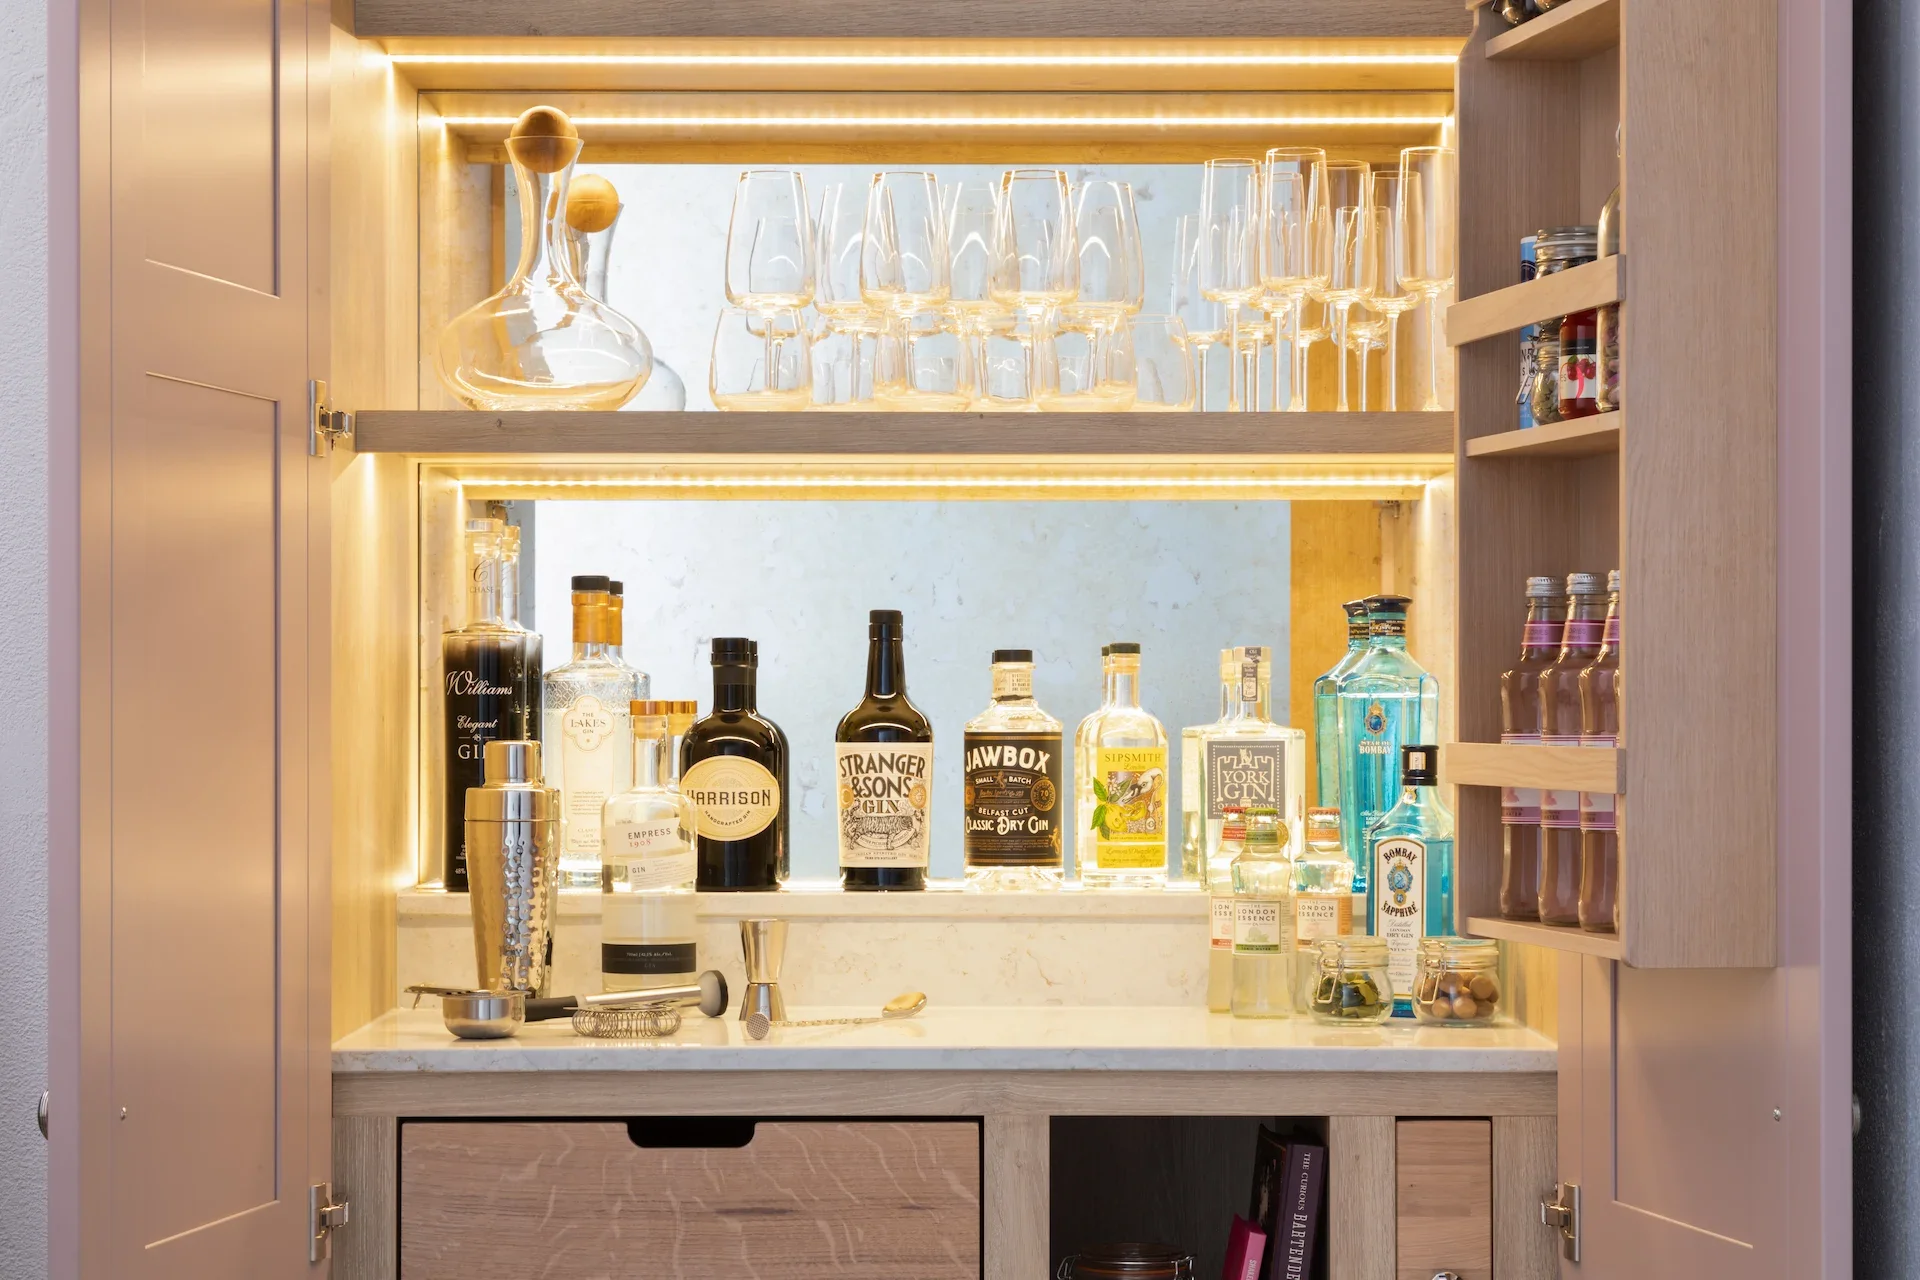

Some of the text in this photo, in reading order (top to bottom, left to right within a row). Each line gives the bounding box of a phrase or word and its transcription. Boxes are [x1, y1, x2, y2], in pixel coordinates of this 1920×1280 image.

[470, 586, 494, 594] CHASE
[446, 670, 513, 696] Williams
[457, 714, 498, 733] Elegant
[570, 719, 607, 728] LAKES
[458, 744, 486, 760] GI
[1104, 753, 1163, 762] SIPSMITH
[1358, 745, 1393, 755] BOMBAY
[840, 752, 926, 778] STRANGER
[966, 745, 1051, 774] JAWBOX
[975, 775, 1032, 785] SMALL BATCH
[1222, 770, 1270, 784] YORK
[851, 776, 912, 798] &SONS
[1040, 789, 1049, 797] 70
[1223, 782, 1269, 800] GIN
[862, 800, 901, 814] GIN
[978, 807, 1029, 817] BELFAST CUT
[704, 809, 751, 827] HANDCRAFTED GIN
[628, 827, 672, 840] EMPRESS
[965, 816, 1049, 836] CLASSIC DRY GIN
[629, 839, 652, 848] 1908
[1383, 847, 1417, 865] BOMBAY
[632, 866, 646, 874] GIN
[1381, 900, 1420, 917] SAPPHIRE
[1286, 1152, 1311, 1280] THE CURIOUS BARTENDE
